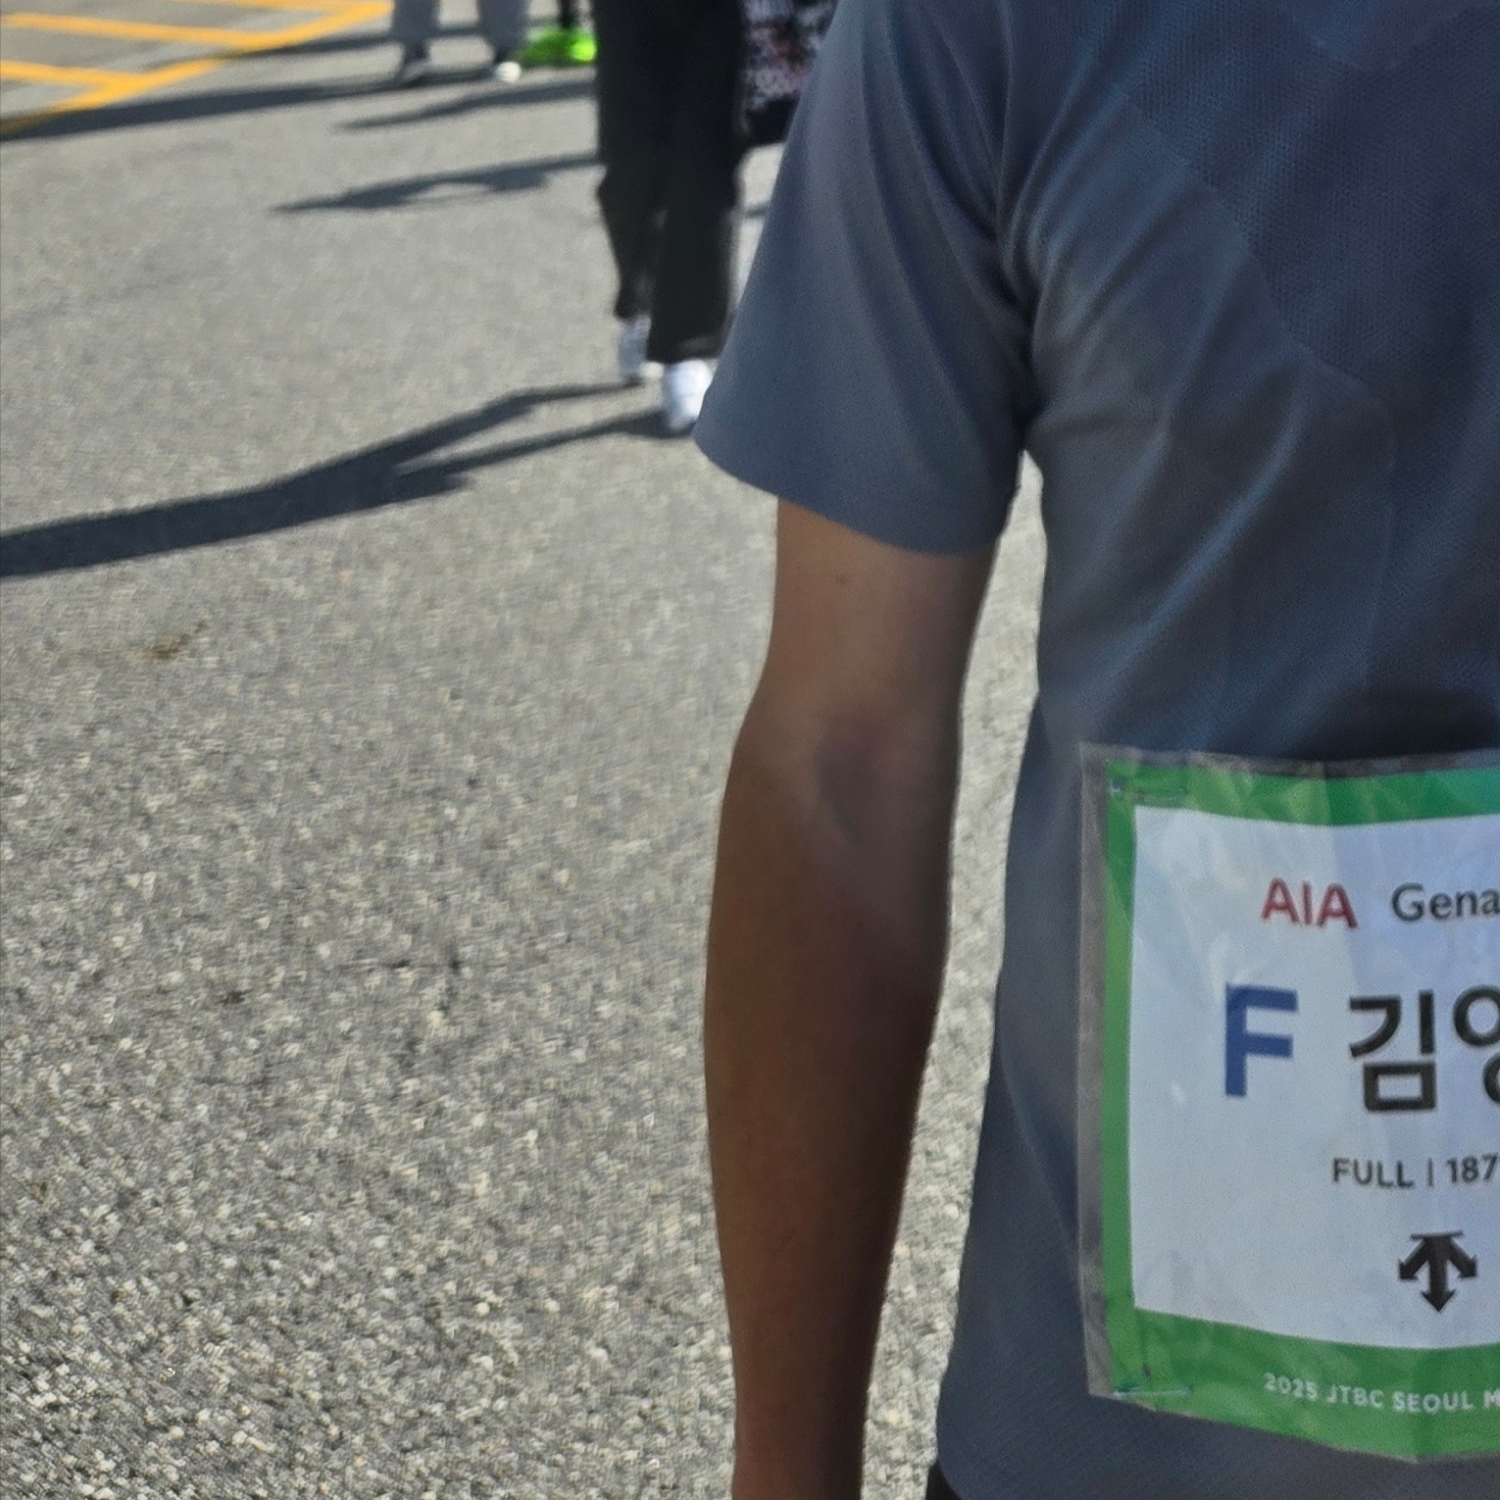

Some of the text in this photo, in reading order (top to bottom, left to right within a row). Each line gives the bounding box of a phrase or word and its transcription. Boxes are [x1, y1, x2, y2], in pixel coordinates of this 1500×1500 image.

[1261, 877, 1358, 929] AIA
[1224, 982, 1298, 1097] F
[1333, 1157, 1415, 1188] FULL
[1264, 1372, 1318, 1401] 2025
[1326, 1384, 1384, 1408] JTBC
[1392, 1390, 1474, 1414] SEOUL
